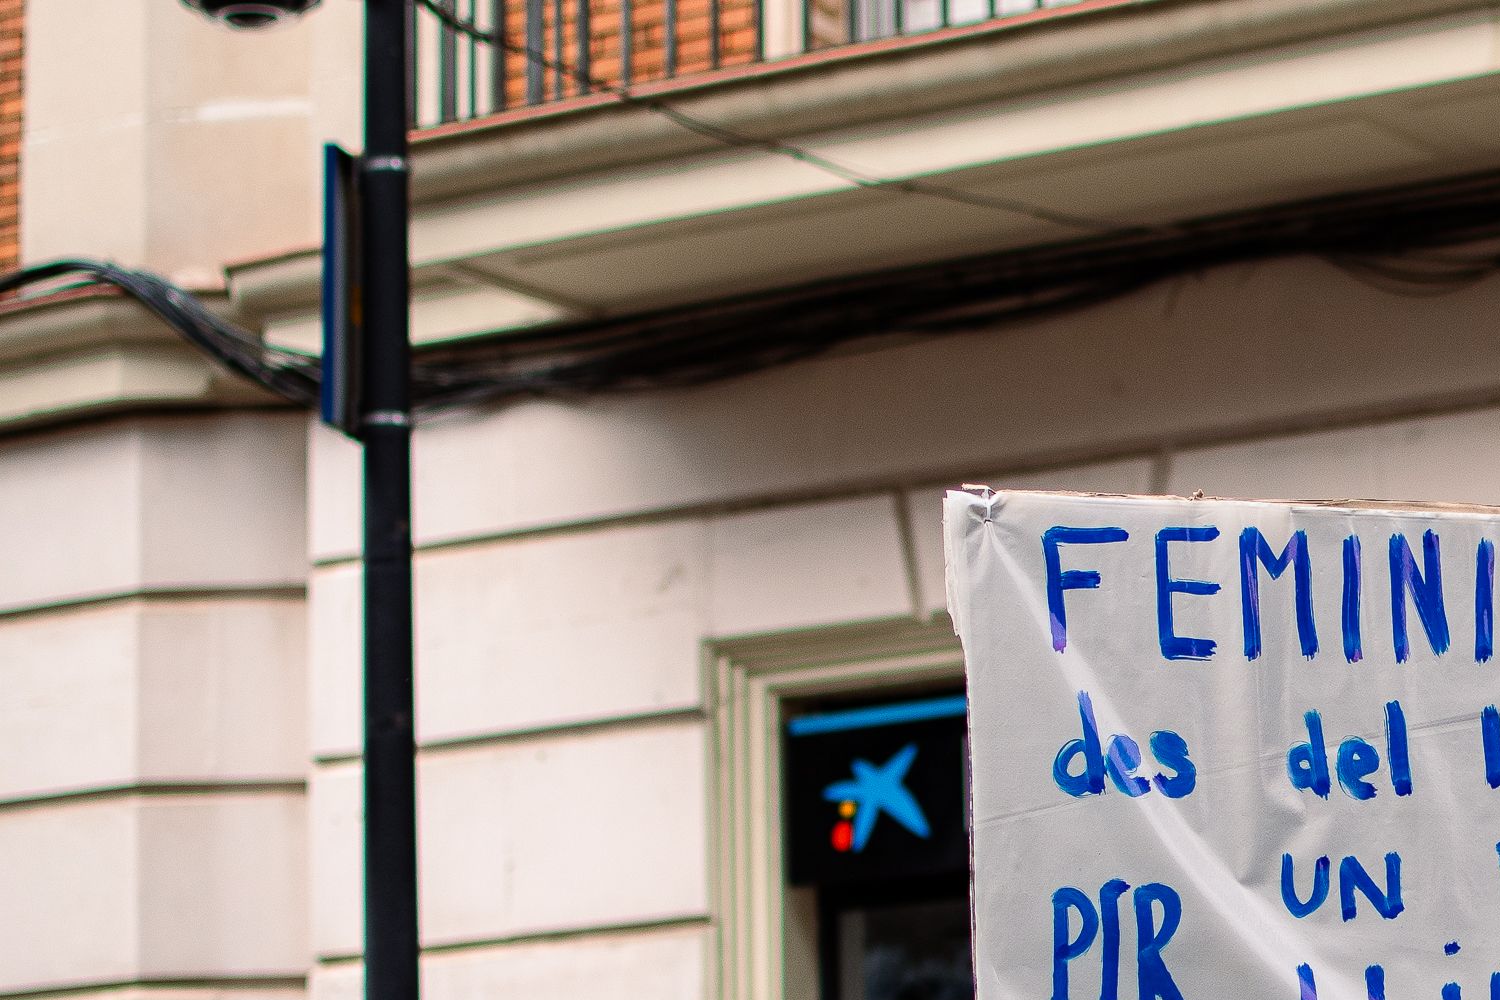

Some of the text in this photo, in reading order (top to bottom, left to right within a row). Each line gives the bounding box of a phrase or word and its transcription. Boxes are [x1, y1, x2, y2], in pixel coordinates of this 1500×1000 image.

[1052, 690, 1197, 798] des
[1287, 700, 1414, 800] del
[1281, 852, 1405, 923] UN
